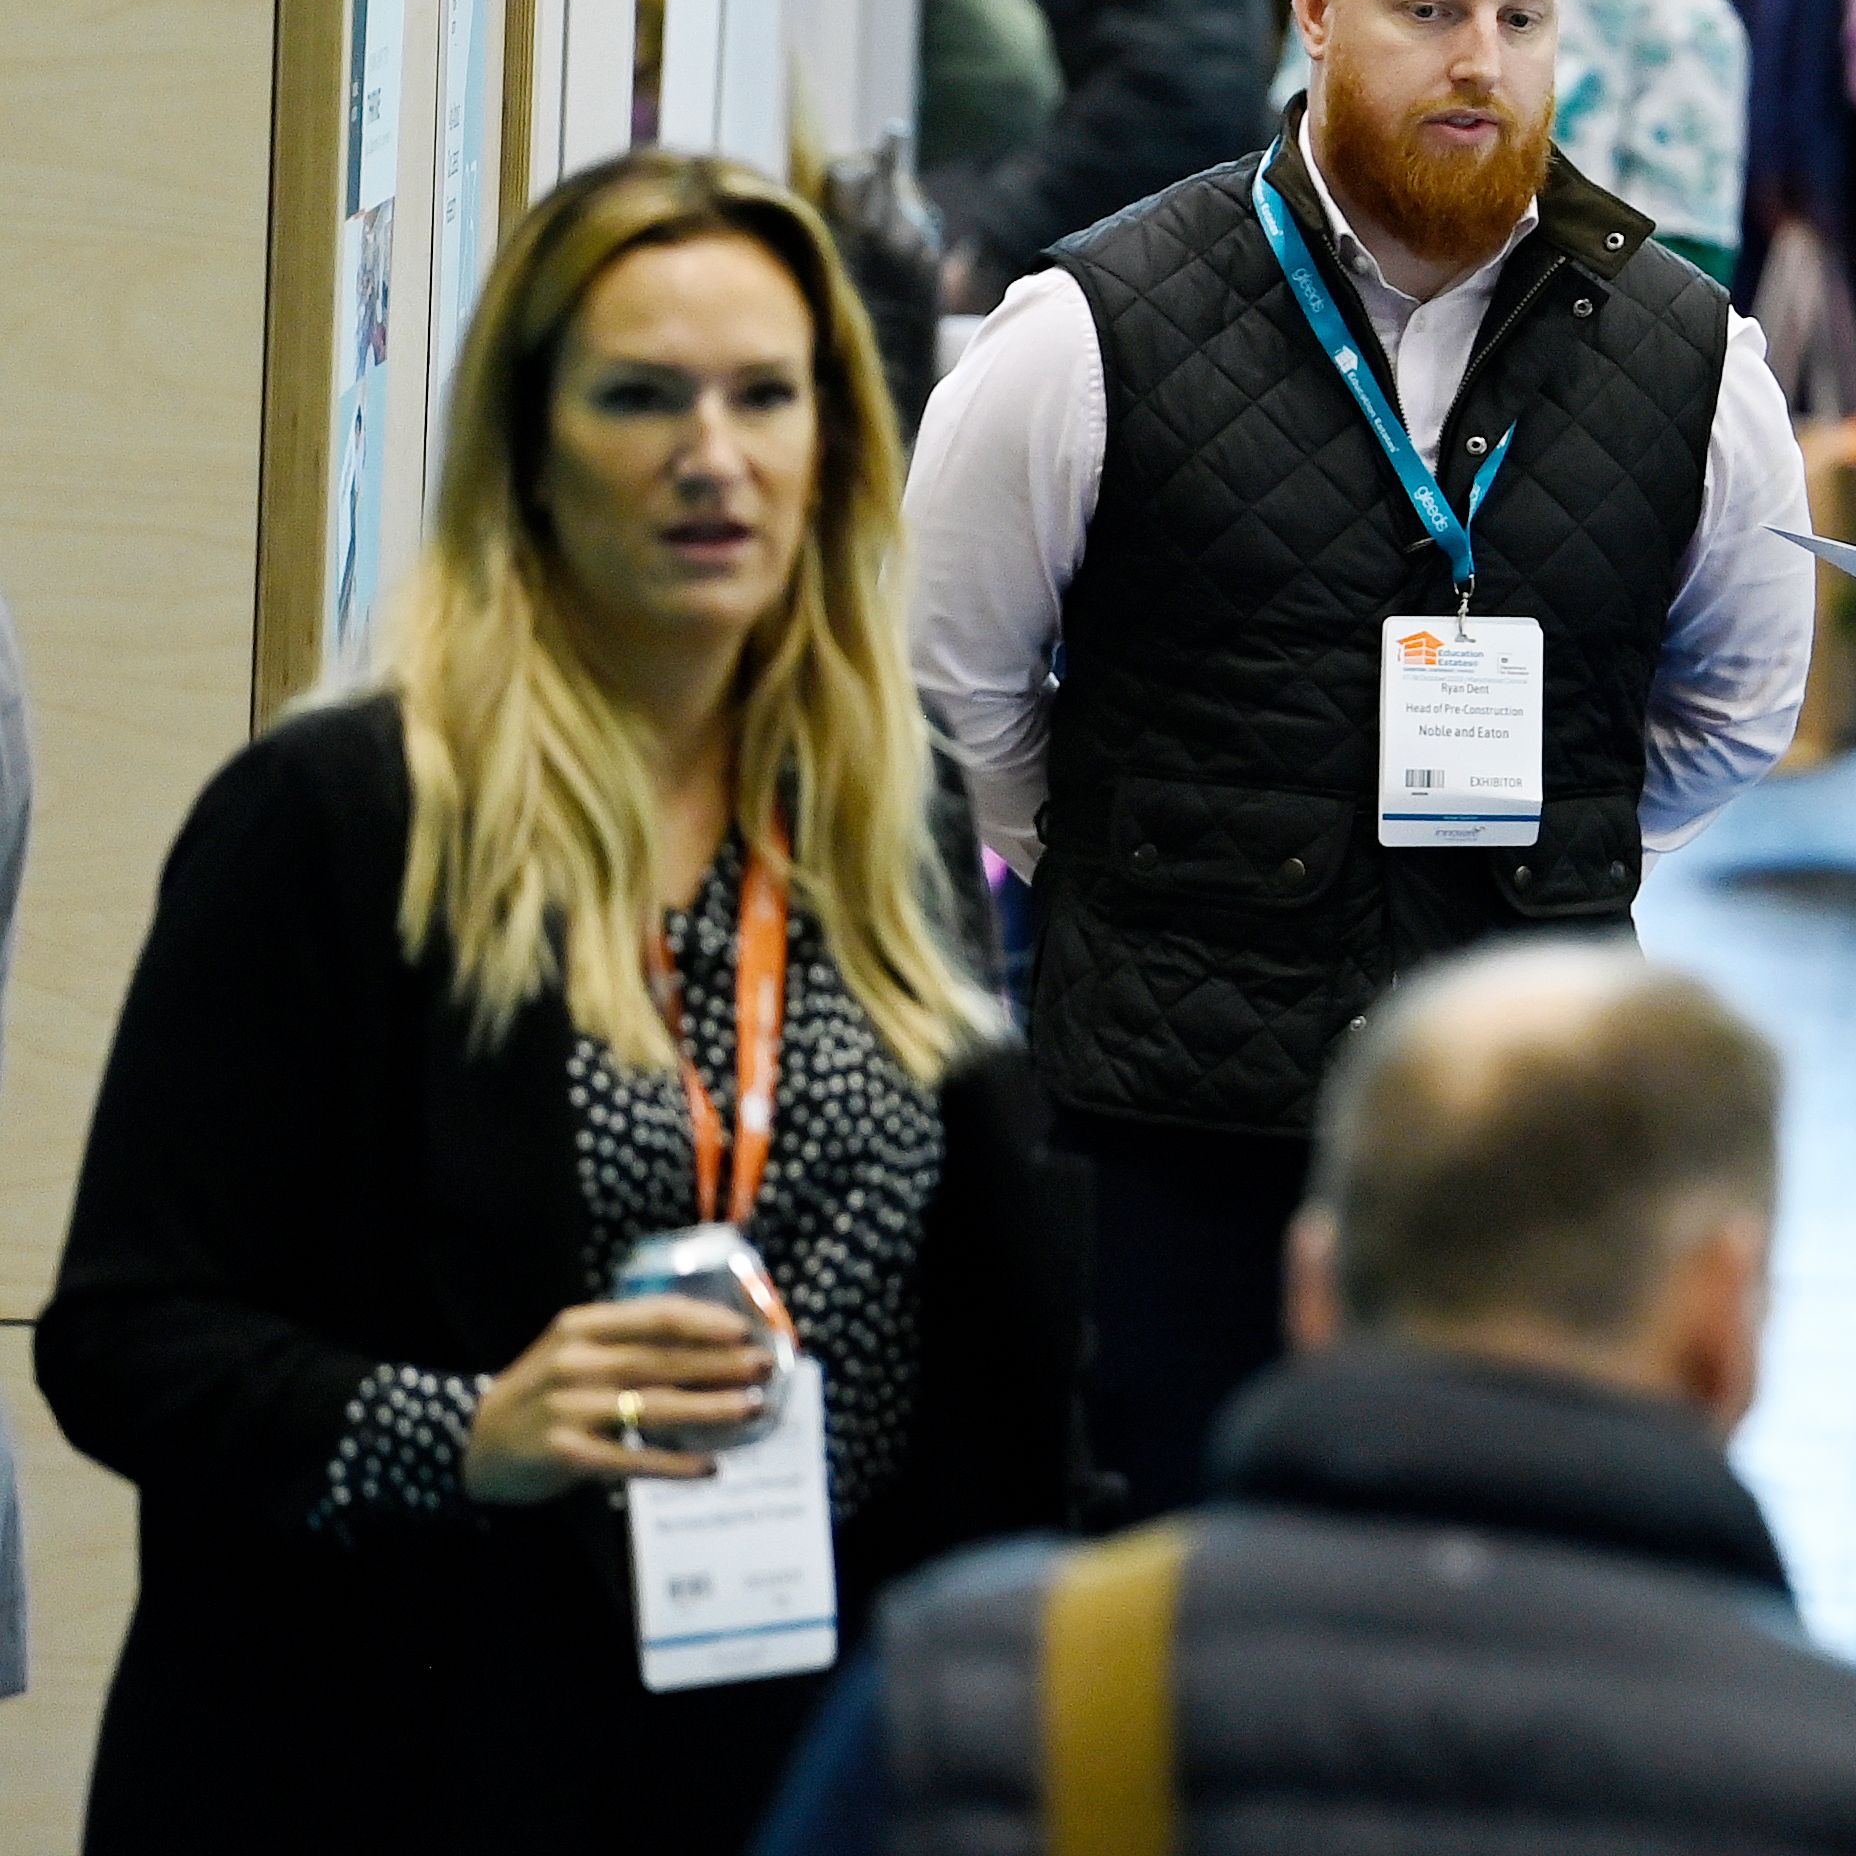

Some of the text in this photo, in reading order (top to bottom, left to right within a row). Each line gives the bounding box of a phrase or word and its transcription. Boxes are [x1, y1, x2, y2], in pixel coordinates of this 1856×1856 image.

[1291, 268, 1324, 313] gleeds
[1347, 370, 1377, 417] Education
[1413, 485, 1448, 532] gleeds
[1438, 649, 1484, 658] Education
[1441, 683, 1490, 695] Ryan Dent
[1406, 703, 1524, 717] Head of Pre-Construction
[1418, 724, 1510, 739] Noble and Eaton
[1470, 776, 1522, 788] EXHIBITOR
